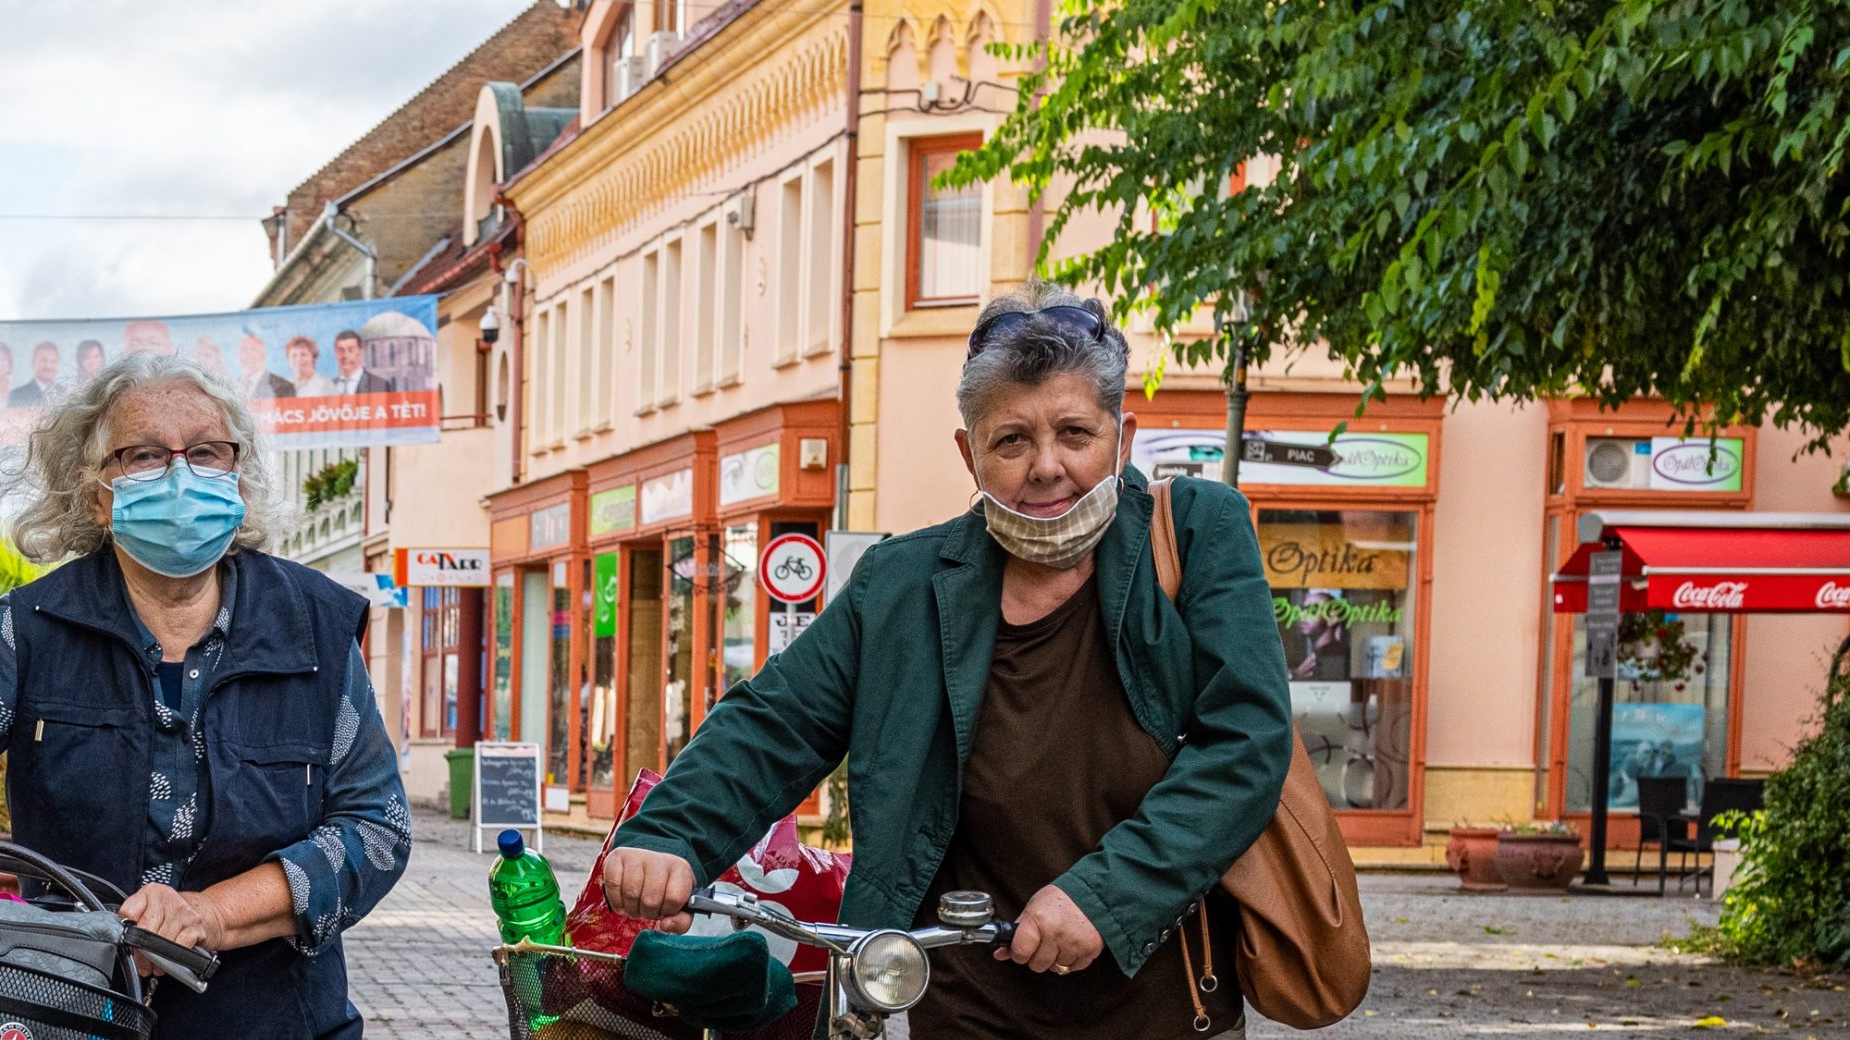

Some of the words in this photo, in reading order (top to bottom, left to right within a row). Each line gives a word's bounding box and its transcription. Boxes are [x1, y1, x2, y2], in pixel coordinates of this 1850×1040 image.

[374, 407, 388, 420] A
[1287, 448, 1315, 463] PIAC
[1267, 540, 1377, 585] Optika
